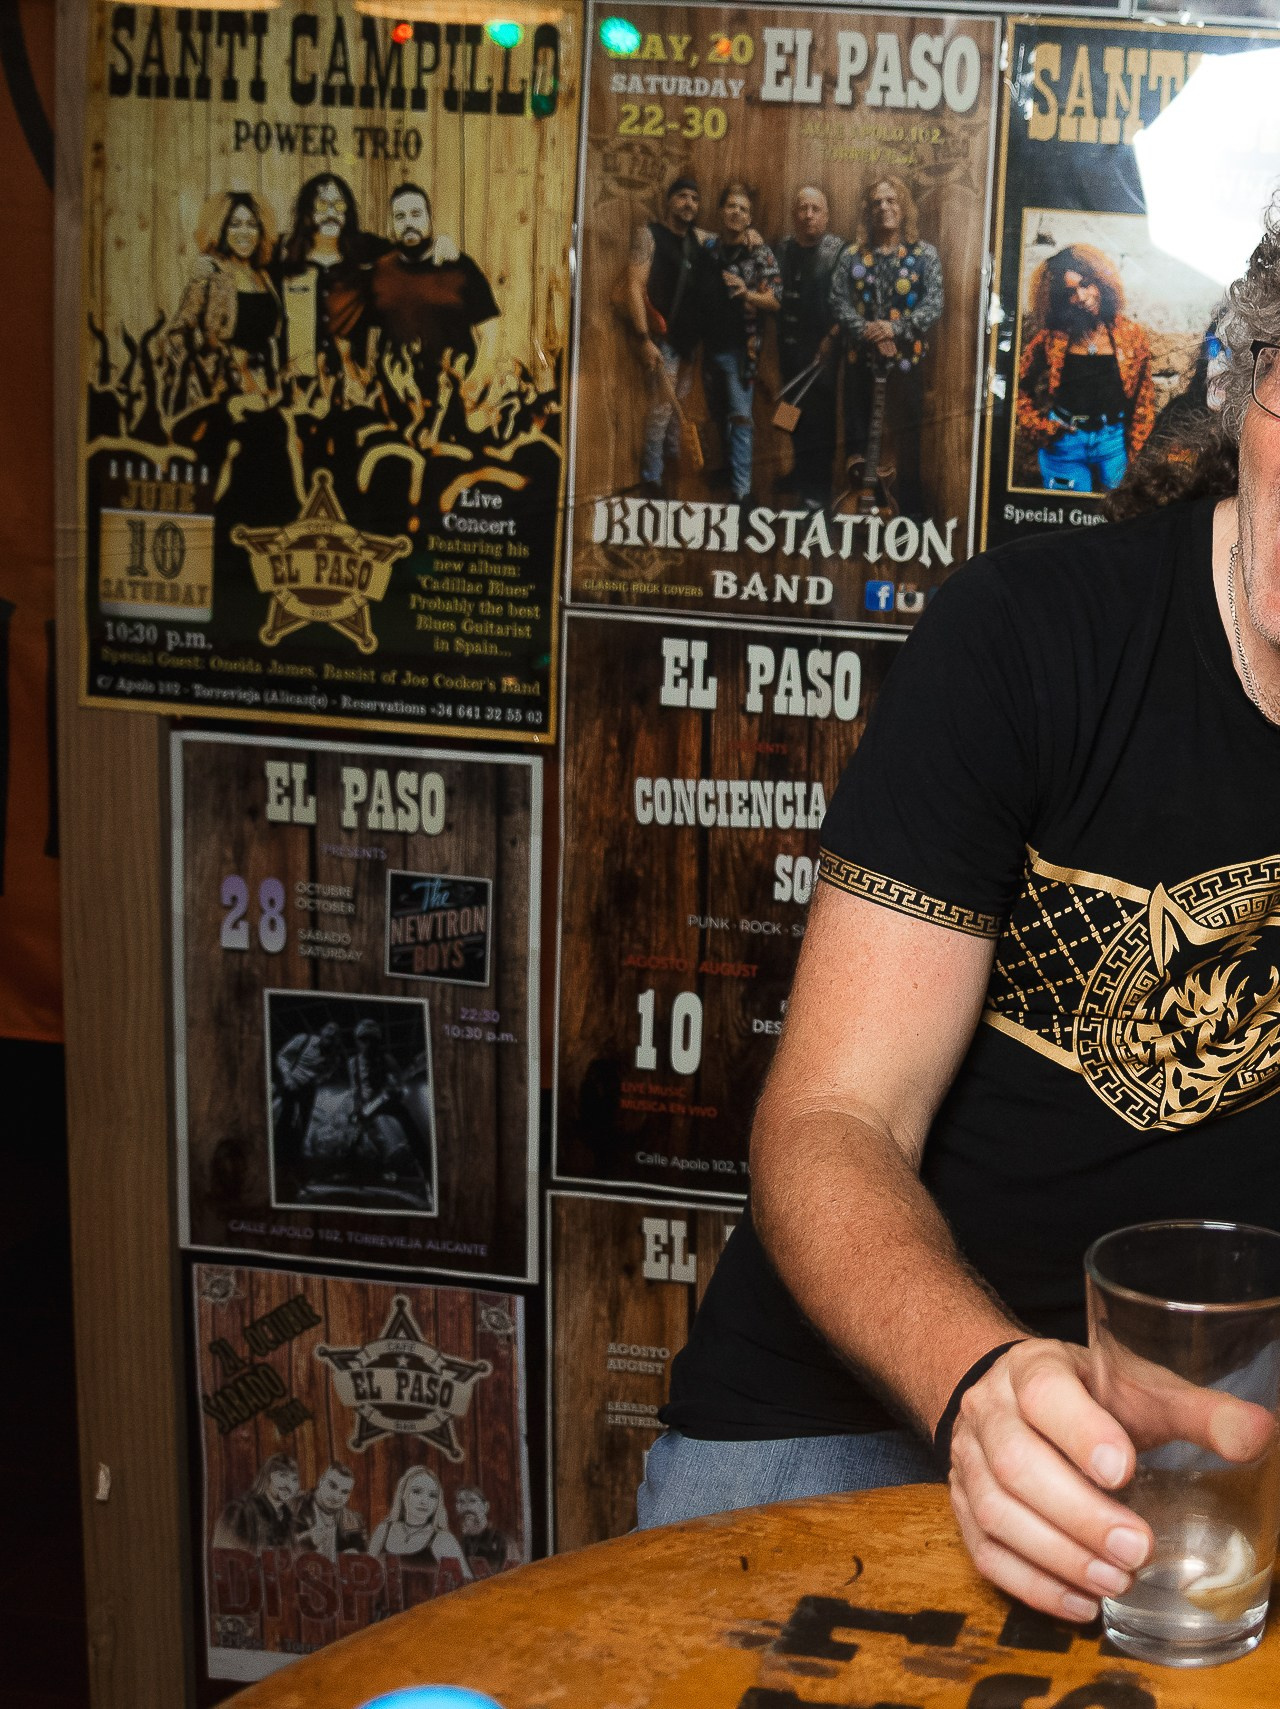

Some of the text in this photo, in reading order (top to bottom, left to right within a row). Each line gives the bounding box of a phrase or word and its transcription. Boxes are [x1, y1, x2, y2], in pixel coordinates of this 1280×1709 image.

[109, 9, 560, 118] SANTI CAMPILLO
[607, 32, 755, 69] AY, 20
[760, 28, 982, 113] EL PASO
[610, 73, 745, 99] SATURDAY
[617, 102, 729, 141] 22-30
[233, 119, 339, 158] POWER
[460, 489, 503, 509] Live
[442, 512, 517, 536] Concert
[593, 498, 740, 553] ROCK
[1003, 503, 1064, 525] Special
[127, 519, 186, 579] 10
[428, 534, 530, 558] Featuring his
[270, 554, 373, 591] EL PASO
[433, 558, 464, 574] new
[102, 578, 208, 606] SATURDAY
[712, 570, 834, 606] BAND
[409, 593, 541, 620] Probably the best
[166, 633, 213, 650] p.m.
[416, 614, 533, 640] Blues Guitarist
[433, 636, 449, 652] in
[323, 662, 376, 683] Bassist
[381, 668, 397, 686] of
[401, 670, 430, 688] Joe
[502, 675, 541, 697] Band
[660, 637, 862, 721] EL PASO
[341, 693, 427, 717] Reservations
[456, 702, 480, 721] 641
[265, 761, 446, 836] EL PASO
[634, 776, 827, 829] CONCIENCIA
[294, 880, 353, 899] OCTUBRE
[412, 877, 450, 911] The
[220, 874, 287, 953] 28
[294, 896, 355, 915] OCTOBER
[391, 906, 486, 945] NEWTRON
[688, 914, 730, 930] PUNK
[739, 919, 782, 935] ROCK
[414, 941, 464, 972] BOYS
[699, 961, 758, 977] AUGUST
[635, 988, 703, 1075] 10
[636, 1151, 669, 1167] Calle
[671, 1156, 710, 1171] Apolo
[346, 1231, 422, 1250] TORREVIEJA
[425, 1238, 489, 1257] ALICANTE
[642, 1217, 697, 1283] EL
[607, 1342, 671, 1360] AGOSTO
[607, 1357, 666, 1376] AUGUST
[351, 1370, 453, 1408] EL PASO
